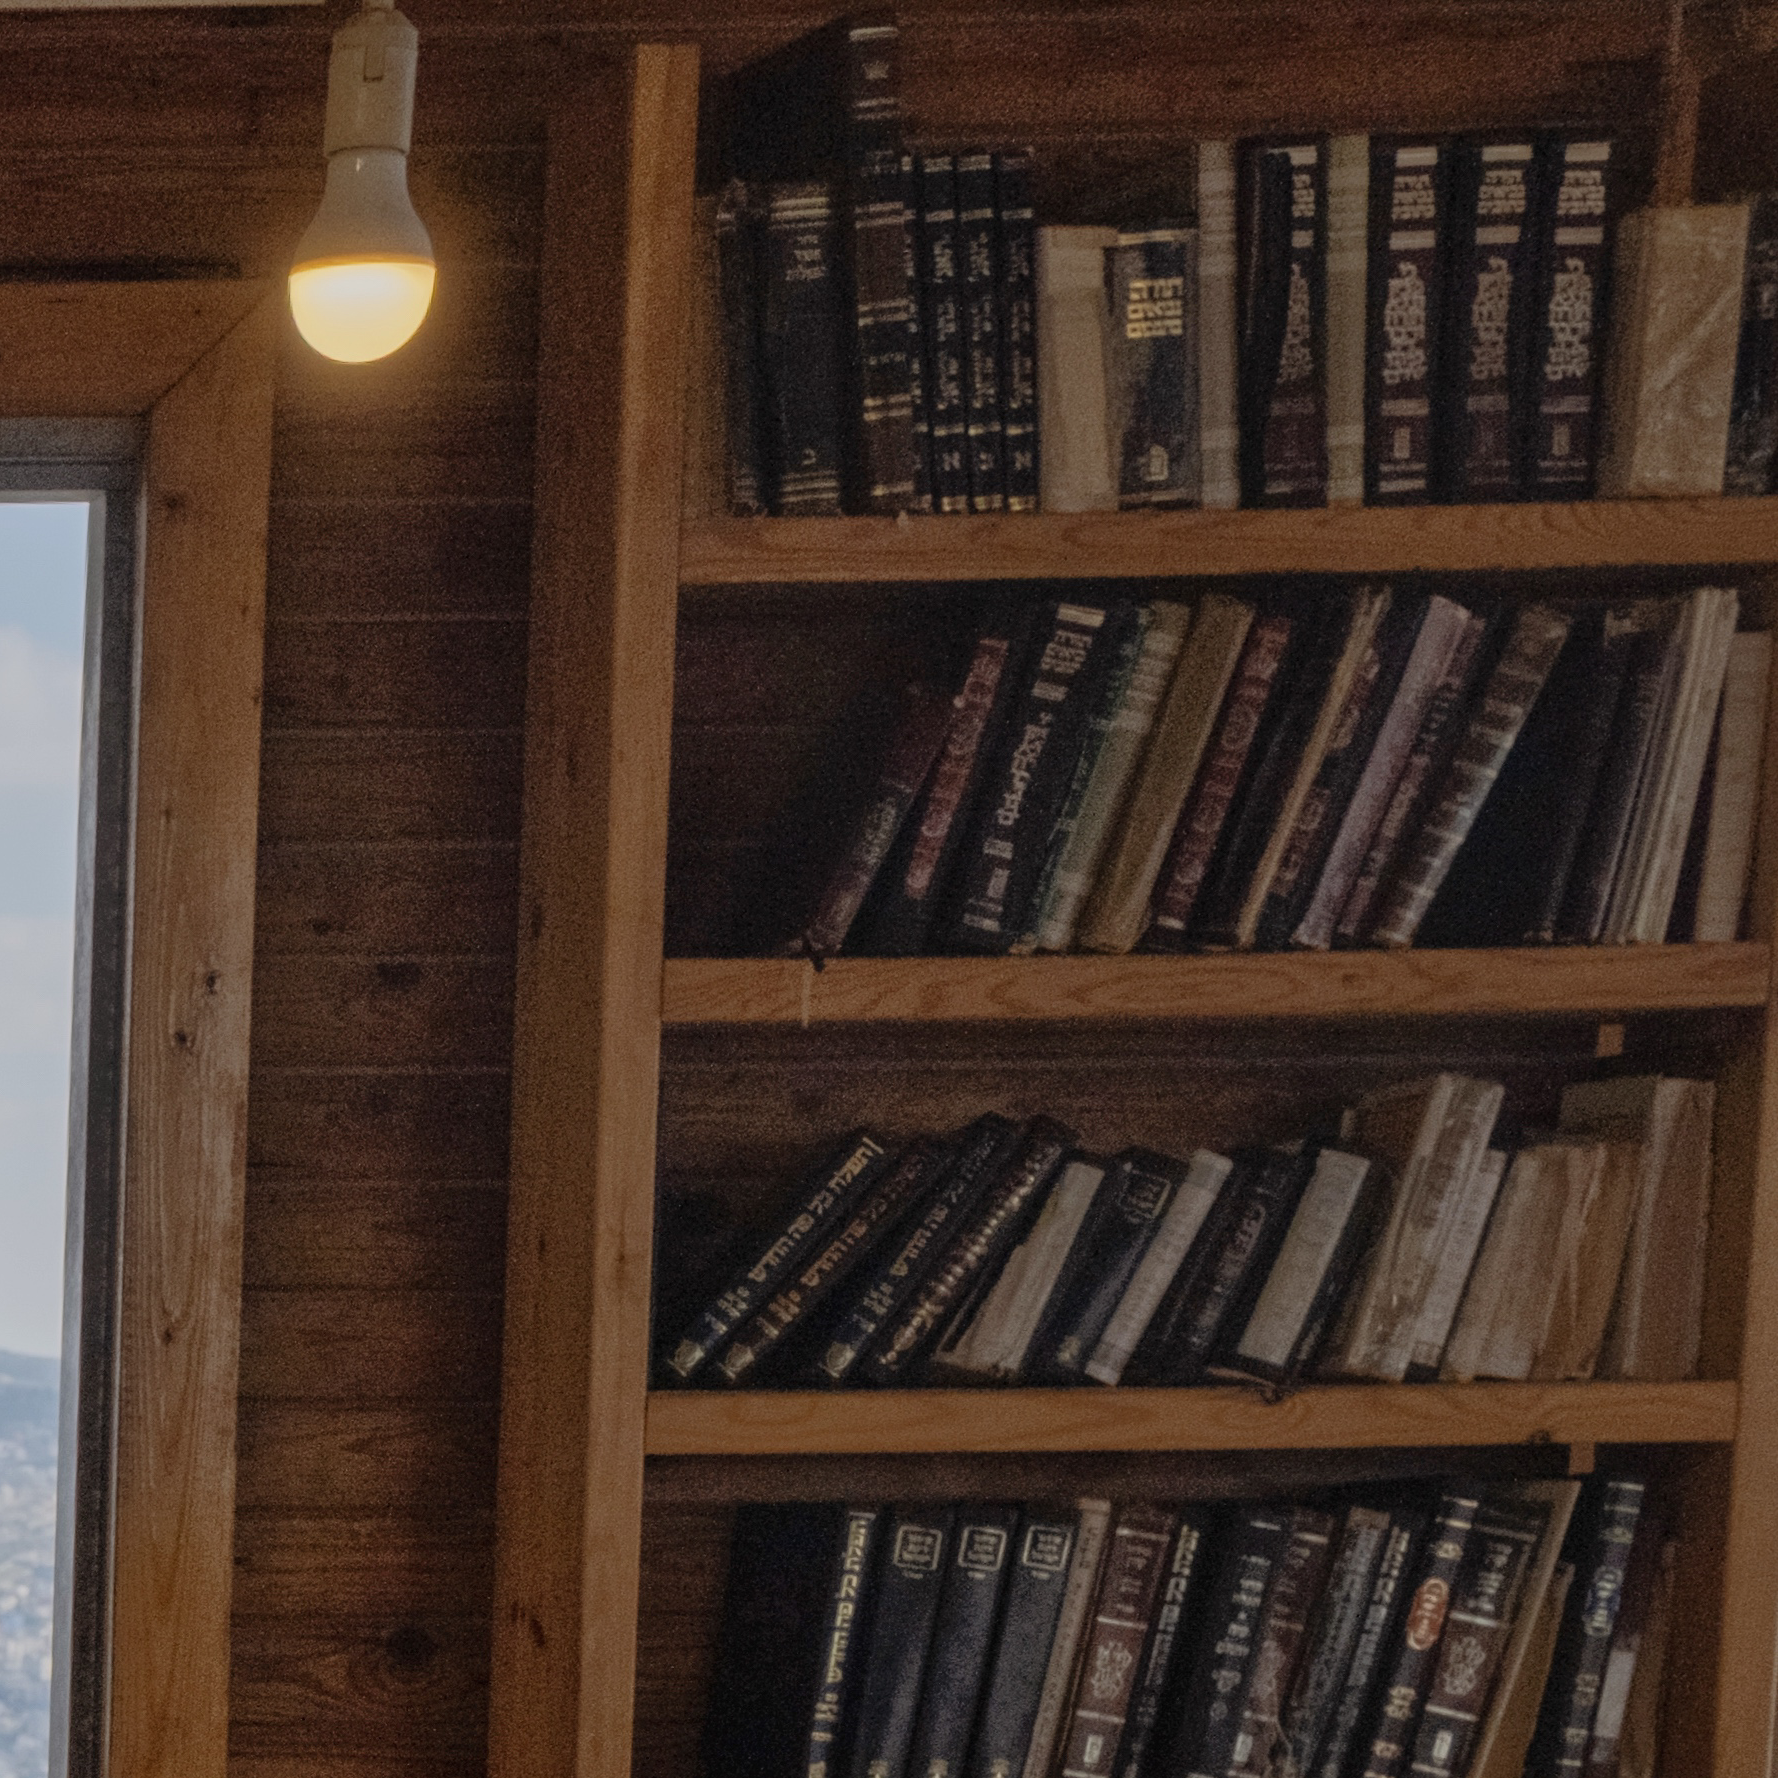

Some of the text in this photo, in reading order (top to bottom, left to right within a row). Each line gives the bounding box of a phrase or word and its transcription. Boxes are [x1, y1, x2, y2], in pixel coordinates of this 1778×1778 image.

[1128, 277, 1183, 299] תורה
[1126, 300, 1183, 318] נביאים
[941, 450, 961, 472] א
[808, 1189, 834, 1216] כל
[787, 1211, 815, 1240] פה
[748, 1235, 795, 1284] החדש
[824, 1516, 867, 1684] תפלת כל פה החדש
[1164, 1575, 1187, 1603] כל
[1158, 1602, 1181, 1632] פה
